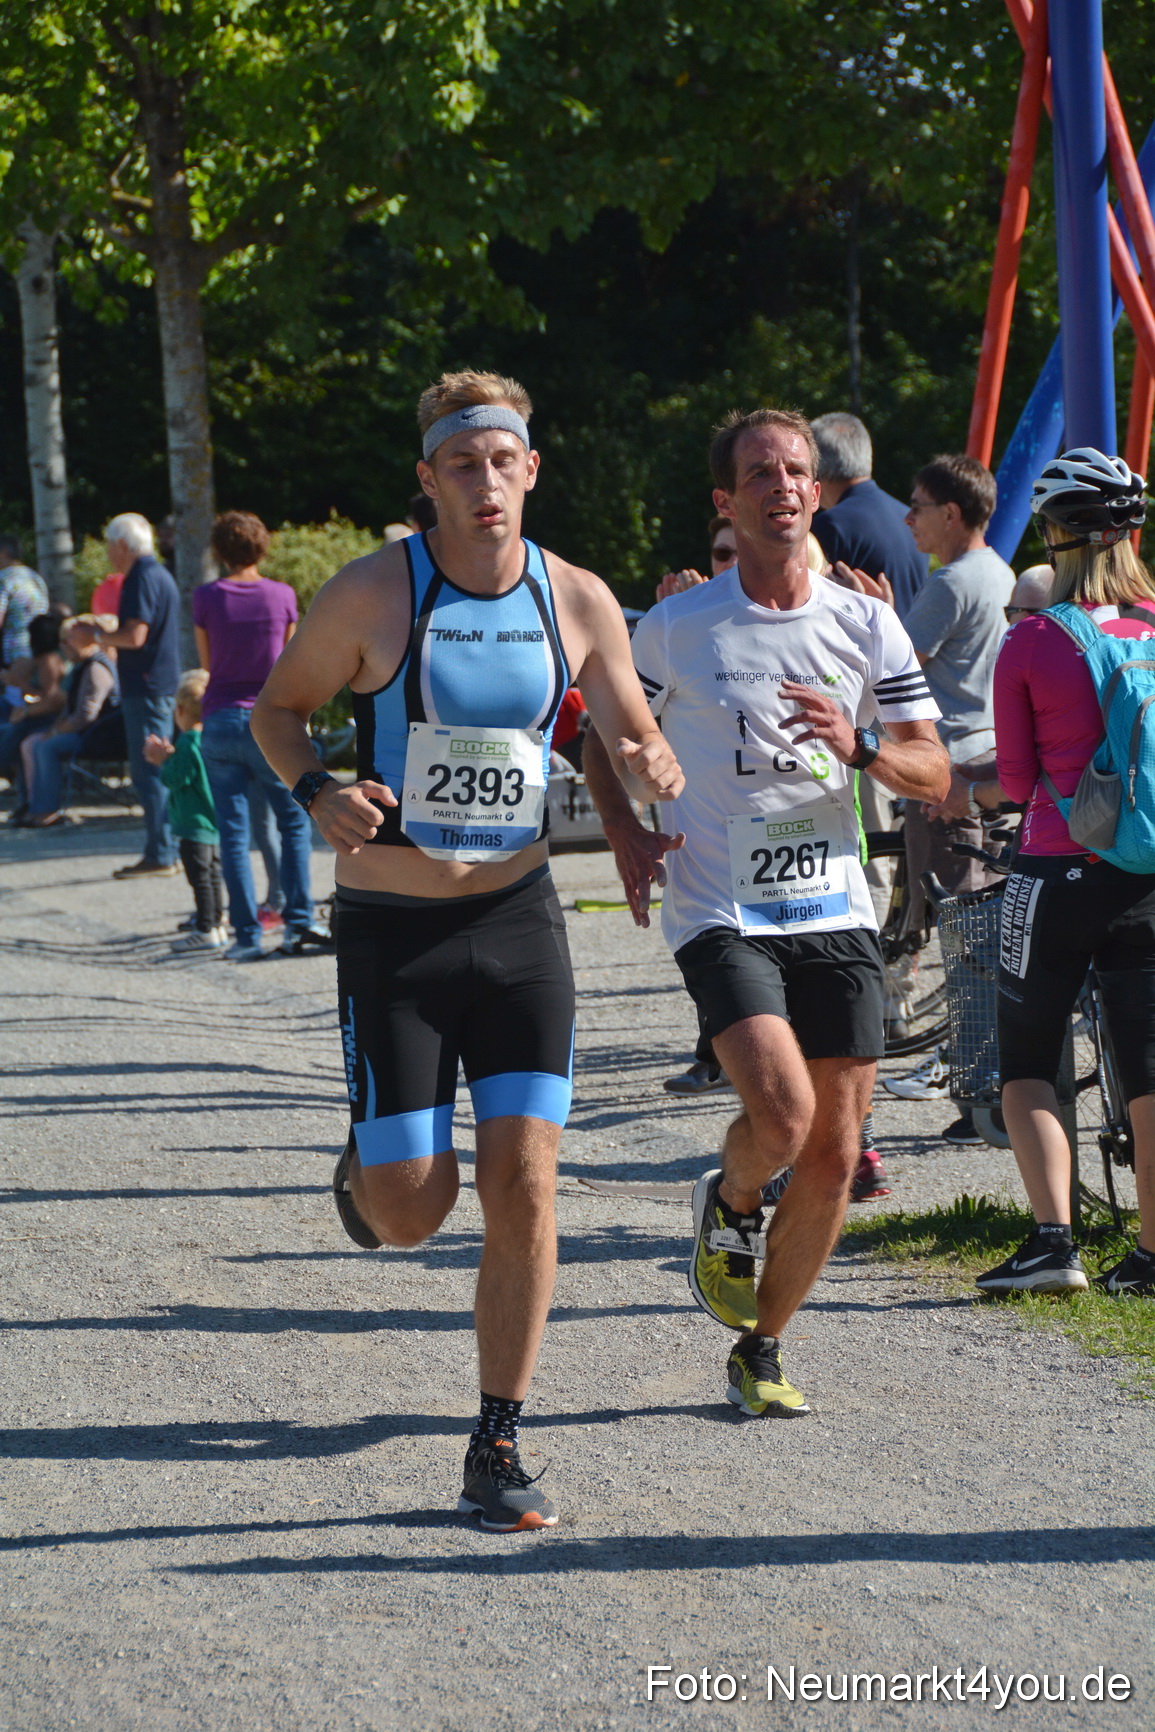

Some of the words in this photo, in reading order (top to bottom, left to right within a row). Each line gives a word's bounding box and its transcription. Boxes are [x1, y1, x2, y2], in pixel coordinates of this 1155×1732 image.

[523, 630, 544, 642] RACER
[715, 669, 766, 684] weidinger
[450, 739, 511, 756] BOCK
[735, 749, 756, 776] L
[425, 763, 525, 806] 2393
[410, 793, 417, 801] A
[433, 809, 463, 820] PARTL
[465, 812, 503, 821] Neumarkt
[767, 819, 815, 836] BOCK
[440, 828, 503, 848] Thomas
[750, 840, 829, 885] 2267
[762, 888, 789, 898] PARTL
[790, 884, 822, 895] Neumarkt
[1013, 875, 1035, 926] ROTHSEE
[775, 903, 823, 921] Jürgen
[1001, 874, 1023, 948] CARRERA
[1011, 928, 1023, 976] TRITEAM
[1001, 951, 1011, 973] LA
